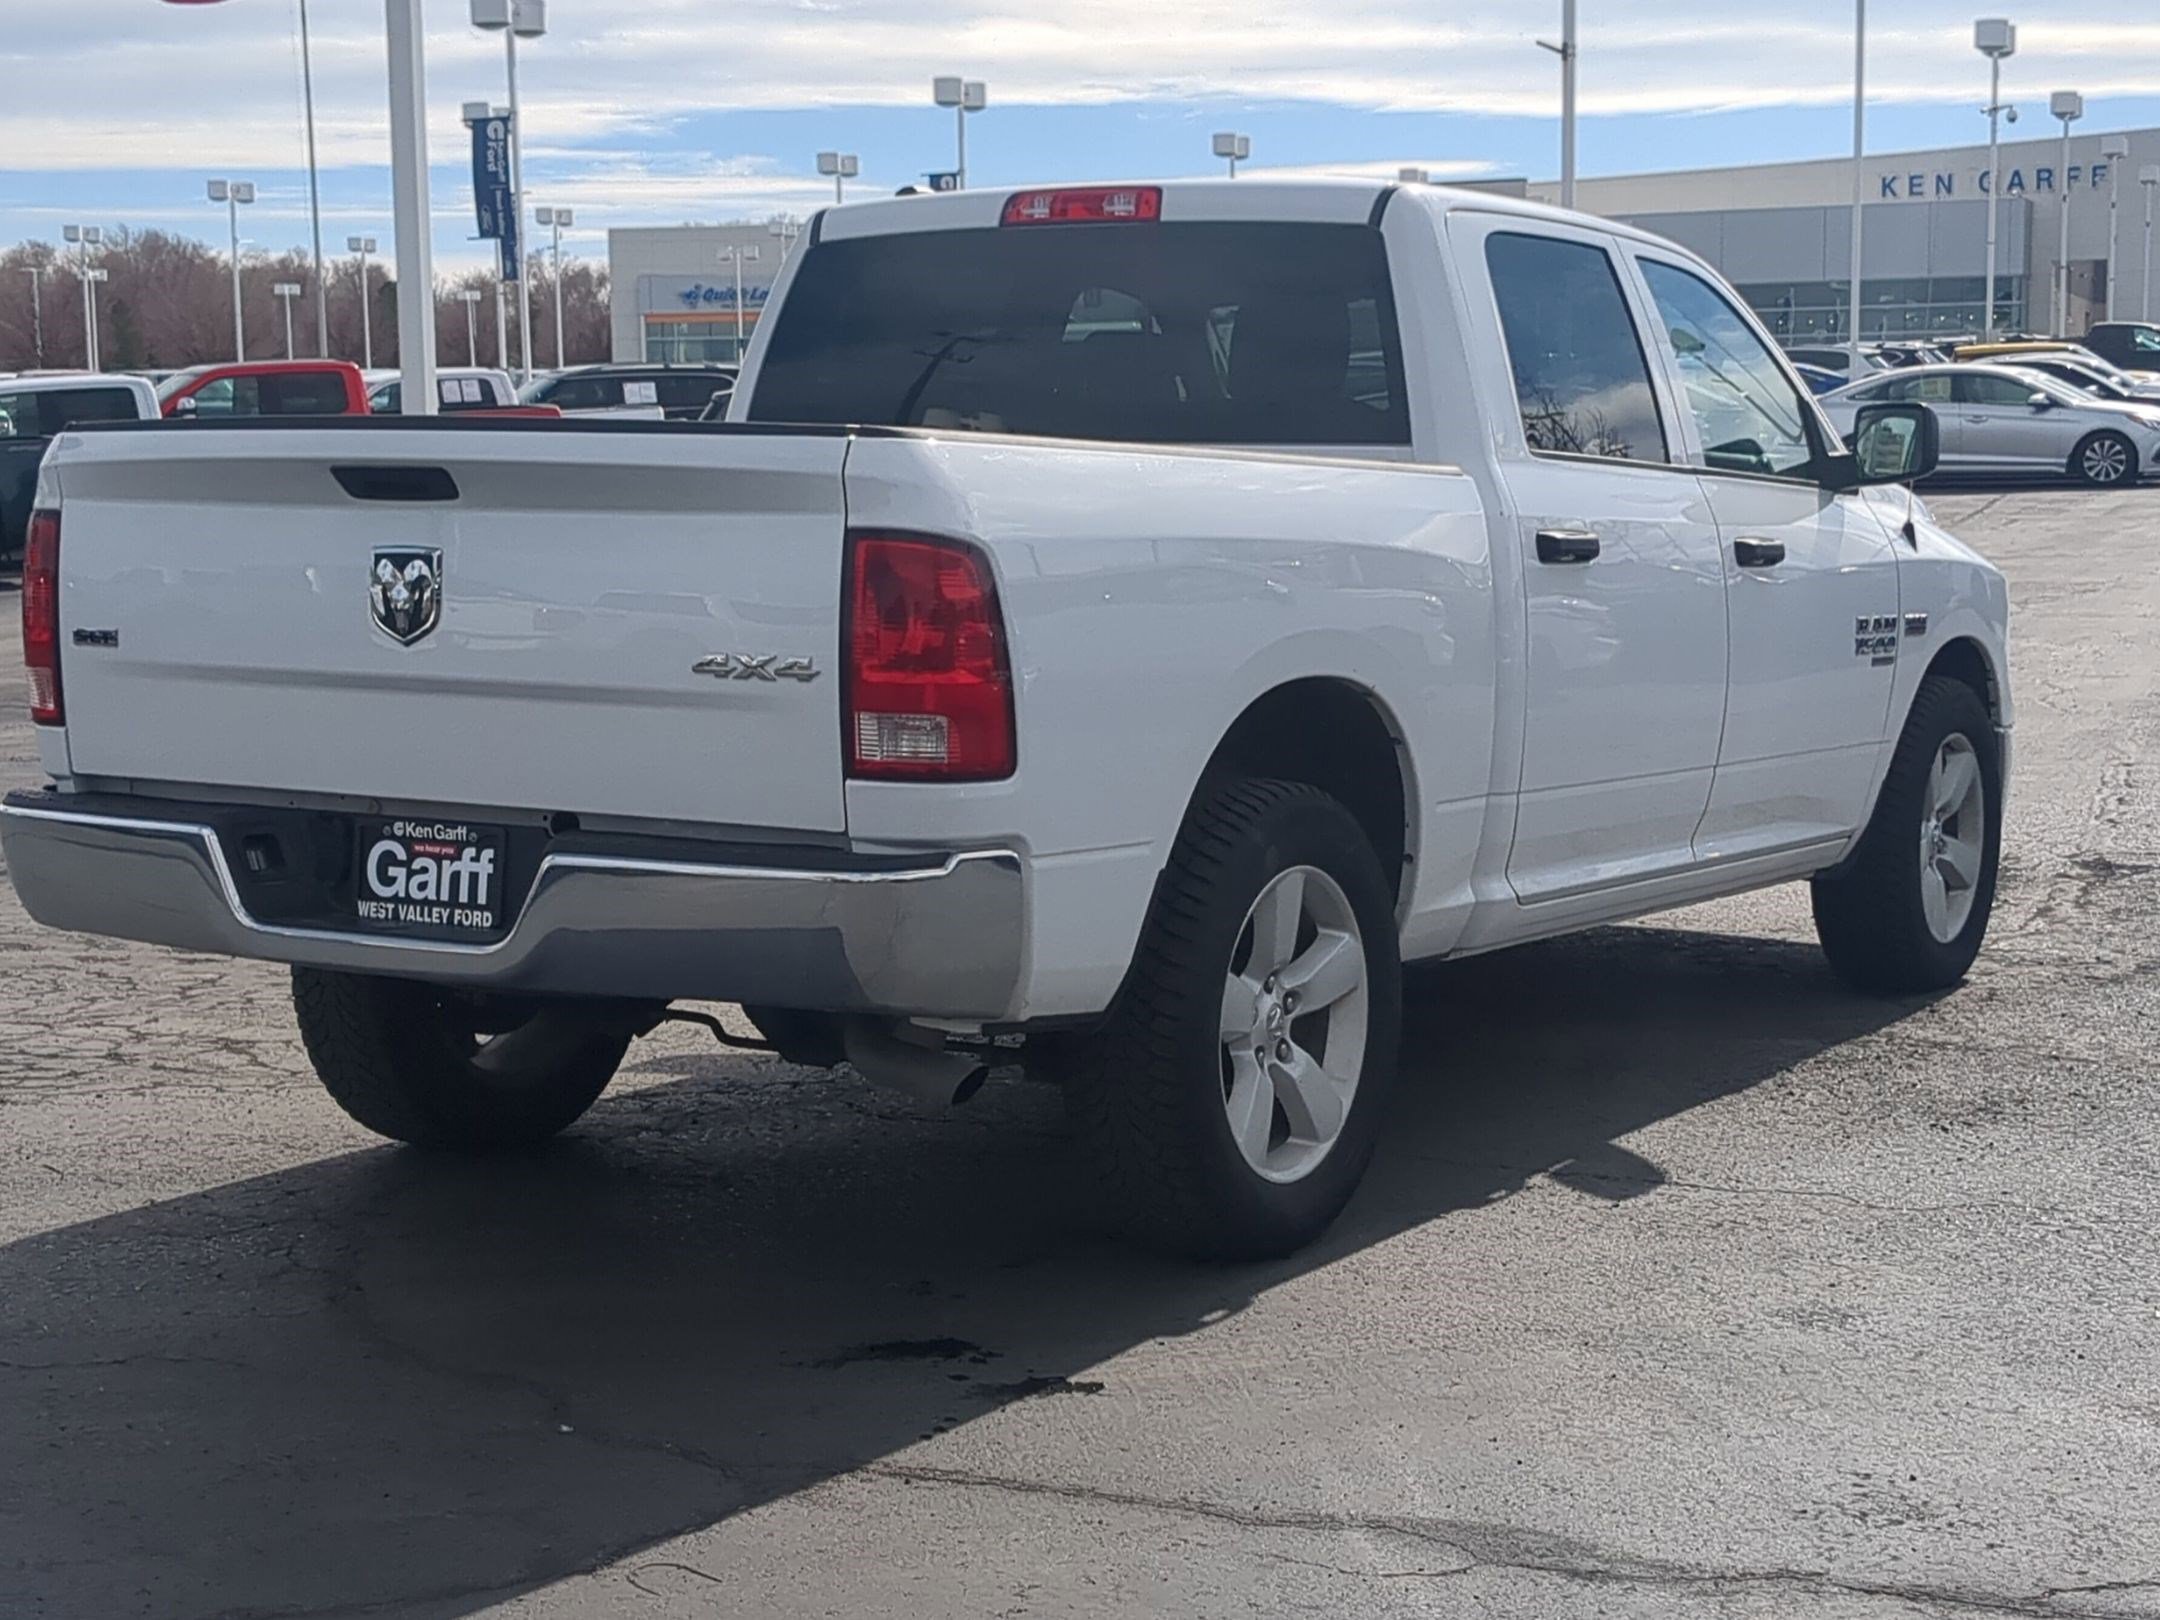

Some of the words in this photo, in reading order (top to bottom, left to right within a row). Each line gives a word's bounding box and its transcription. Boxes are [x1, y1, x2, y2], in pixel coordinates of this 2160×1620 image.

[487, 142, 497, 172] Ford
[1881, 172, 1953, 198] KEN
[1856, 614, 1898, 635] RAM
[405, 822, 433, 840] Ken
[433, 824, 467, 841] Garff
[366, 839, 495, 905] Garff
[357, 900, 395, 919] WEST
[398, 903, 450, 924] VALLEY
[453, 908, 493, 928] FORD
